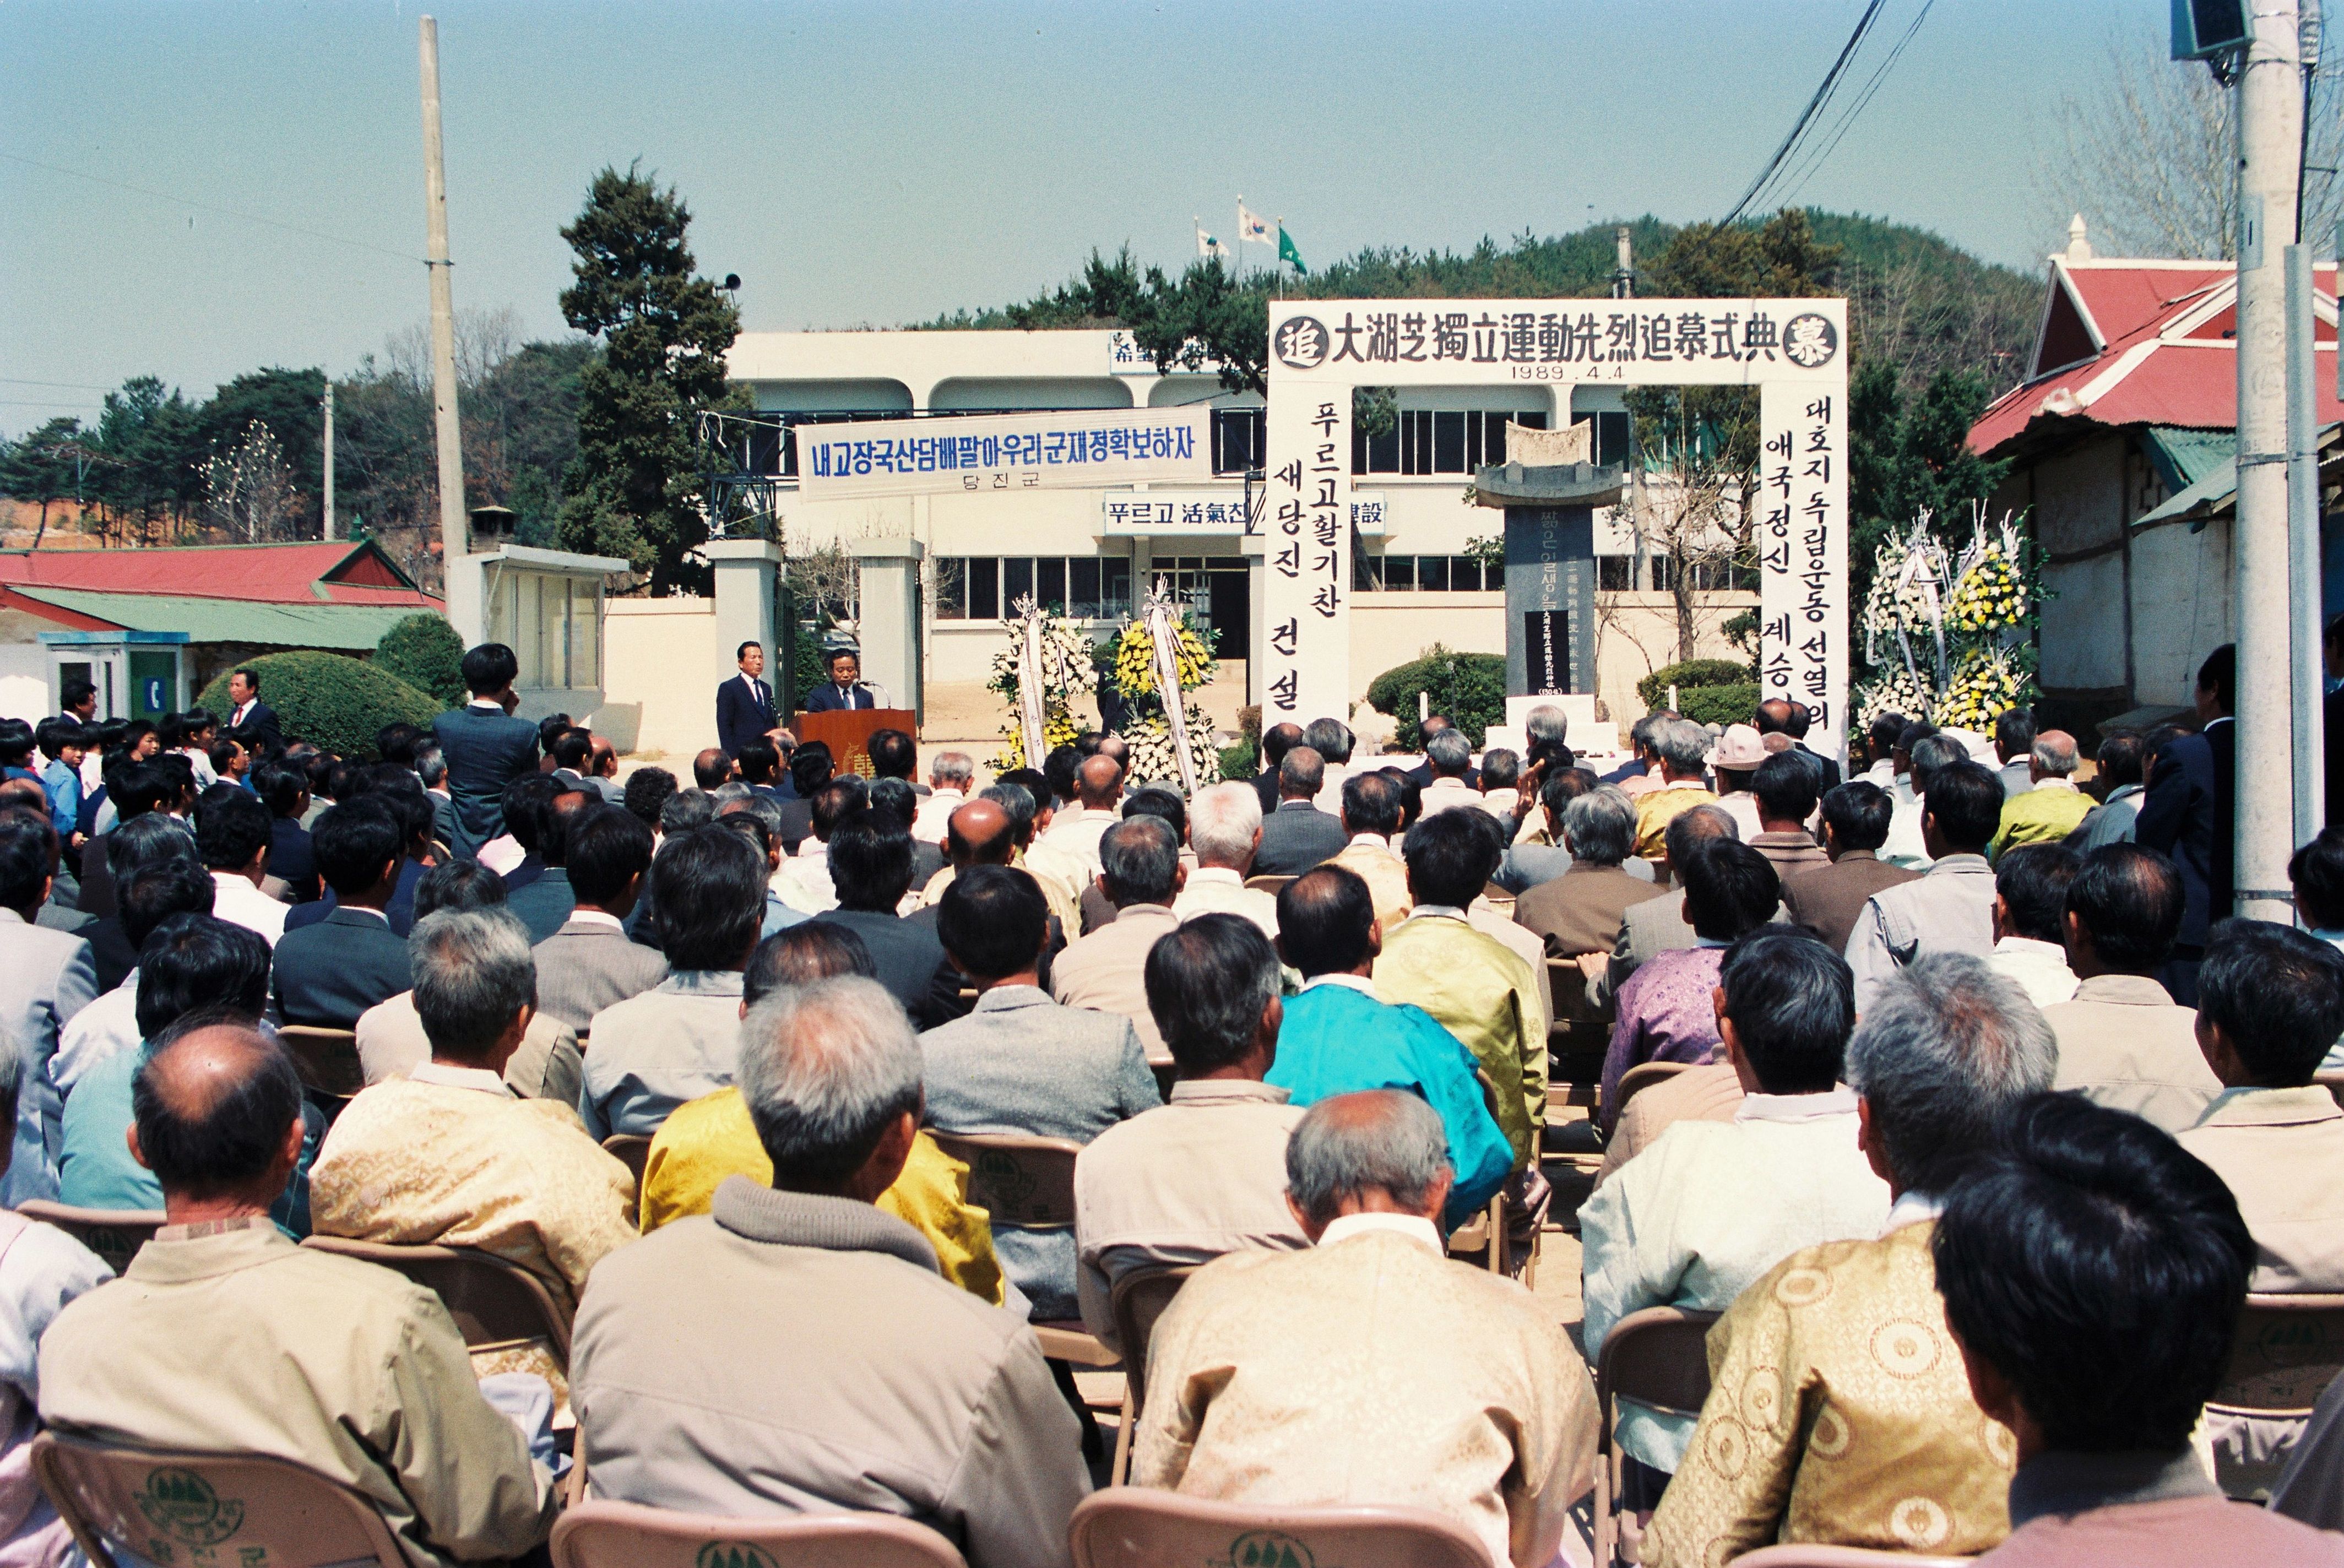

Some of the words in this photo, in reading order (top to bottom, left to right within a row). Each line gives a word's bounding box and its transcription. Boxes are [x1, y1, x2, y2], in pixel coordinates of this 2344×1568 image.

[1281, 319, 1321, 368] 追
[1332, 312, 1779, 362] 大湖芝獨立運動先烈追慕式典
[1789, 317, 1835, 367] 慕
[1803, 396, 1831, 484] 대호지
[1109, 502, 1174, 524] 푸르고
[1764, 431, 1793, 574] 애국정신
[1799, 492, 1831, 622] 독립운동
[1762, 612, 1793, 702] 계승
